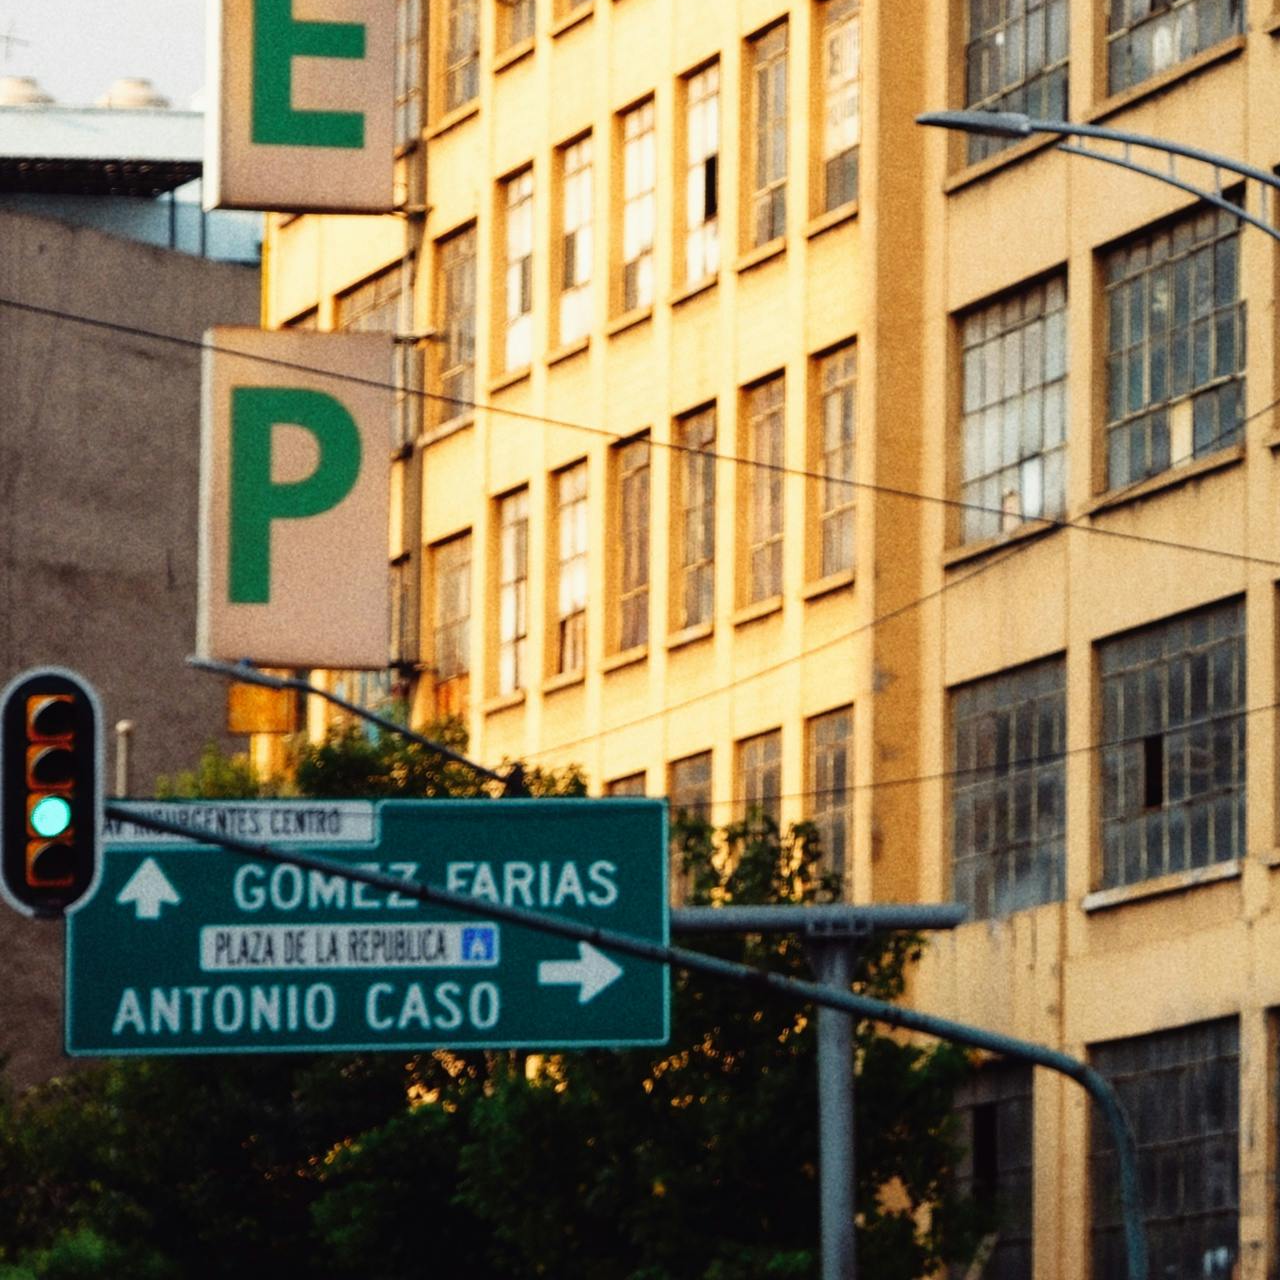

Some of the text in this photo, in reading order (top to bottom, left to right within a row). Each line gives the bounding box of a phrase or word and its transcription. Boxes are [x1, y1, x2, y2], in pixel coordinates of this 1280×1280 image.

[269, 806, 340, 835] CENTRO
[232, 859, 619, 912] GOMEZ FARIAS
[214, 929, 448, 967] PLAZA DE LA REPUBLICA
[112, 980, 500, 1035] ANTONIO CASO
